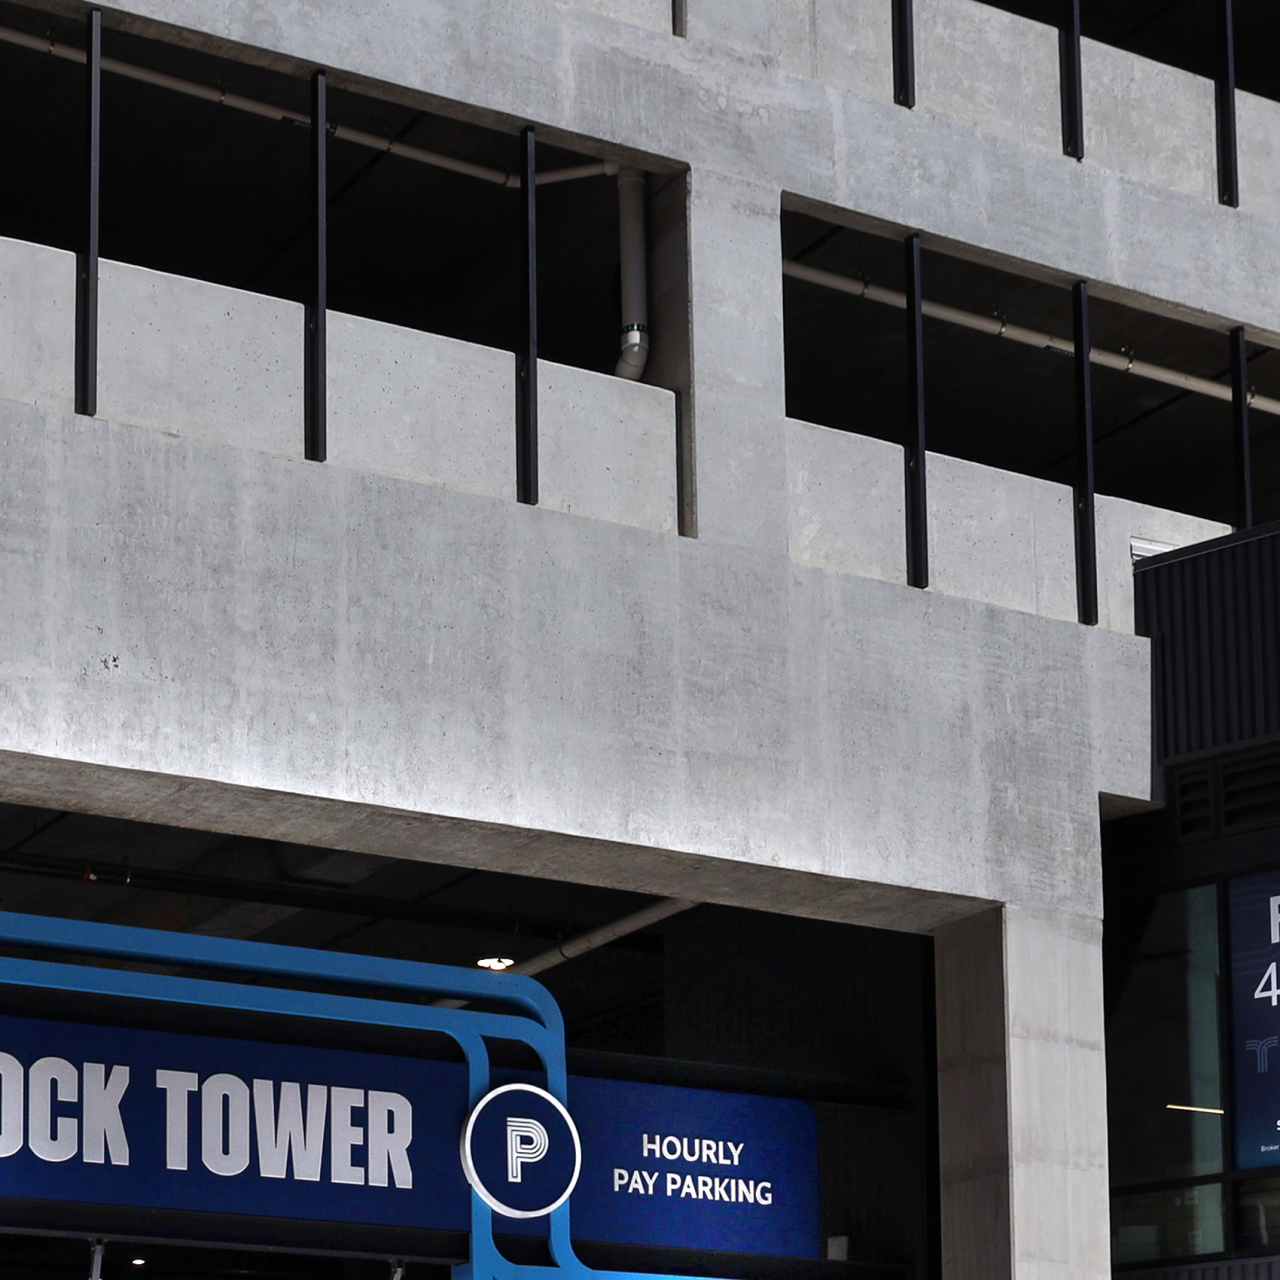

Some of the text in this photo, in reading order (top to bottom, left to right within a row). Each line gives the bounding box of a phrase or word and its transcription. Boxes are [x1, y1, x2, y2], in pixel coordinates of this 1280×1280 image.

[155, 1067, 414, 1190] TOWER
[506, 1116, 549, 1183] P
[641, 1132, 745, 1167] HOURLY
[1260, 1144, 1280, 1152] Broker
[613, 1168, 773, 1206] PAY PARKING
